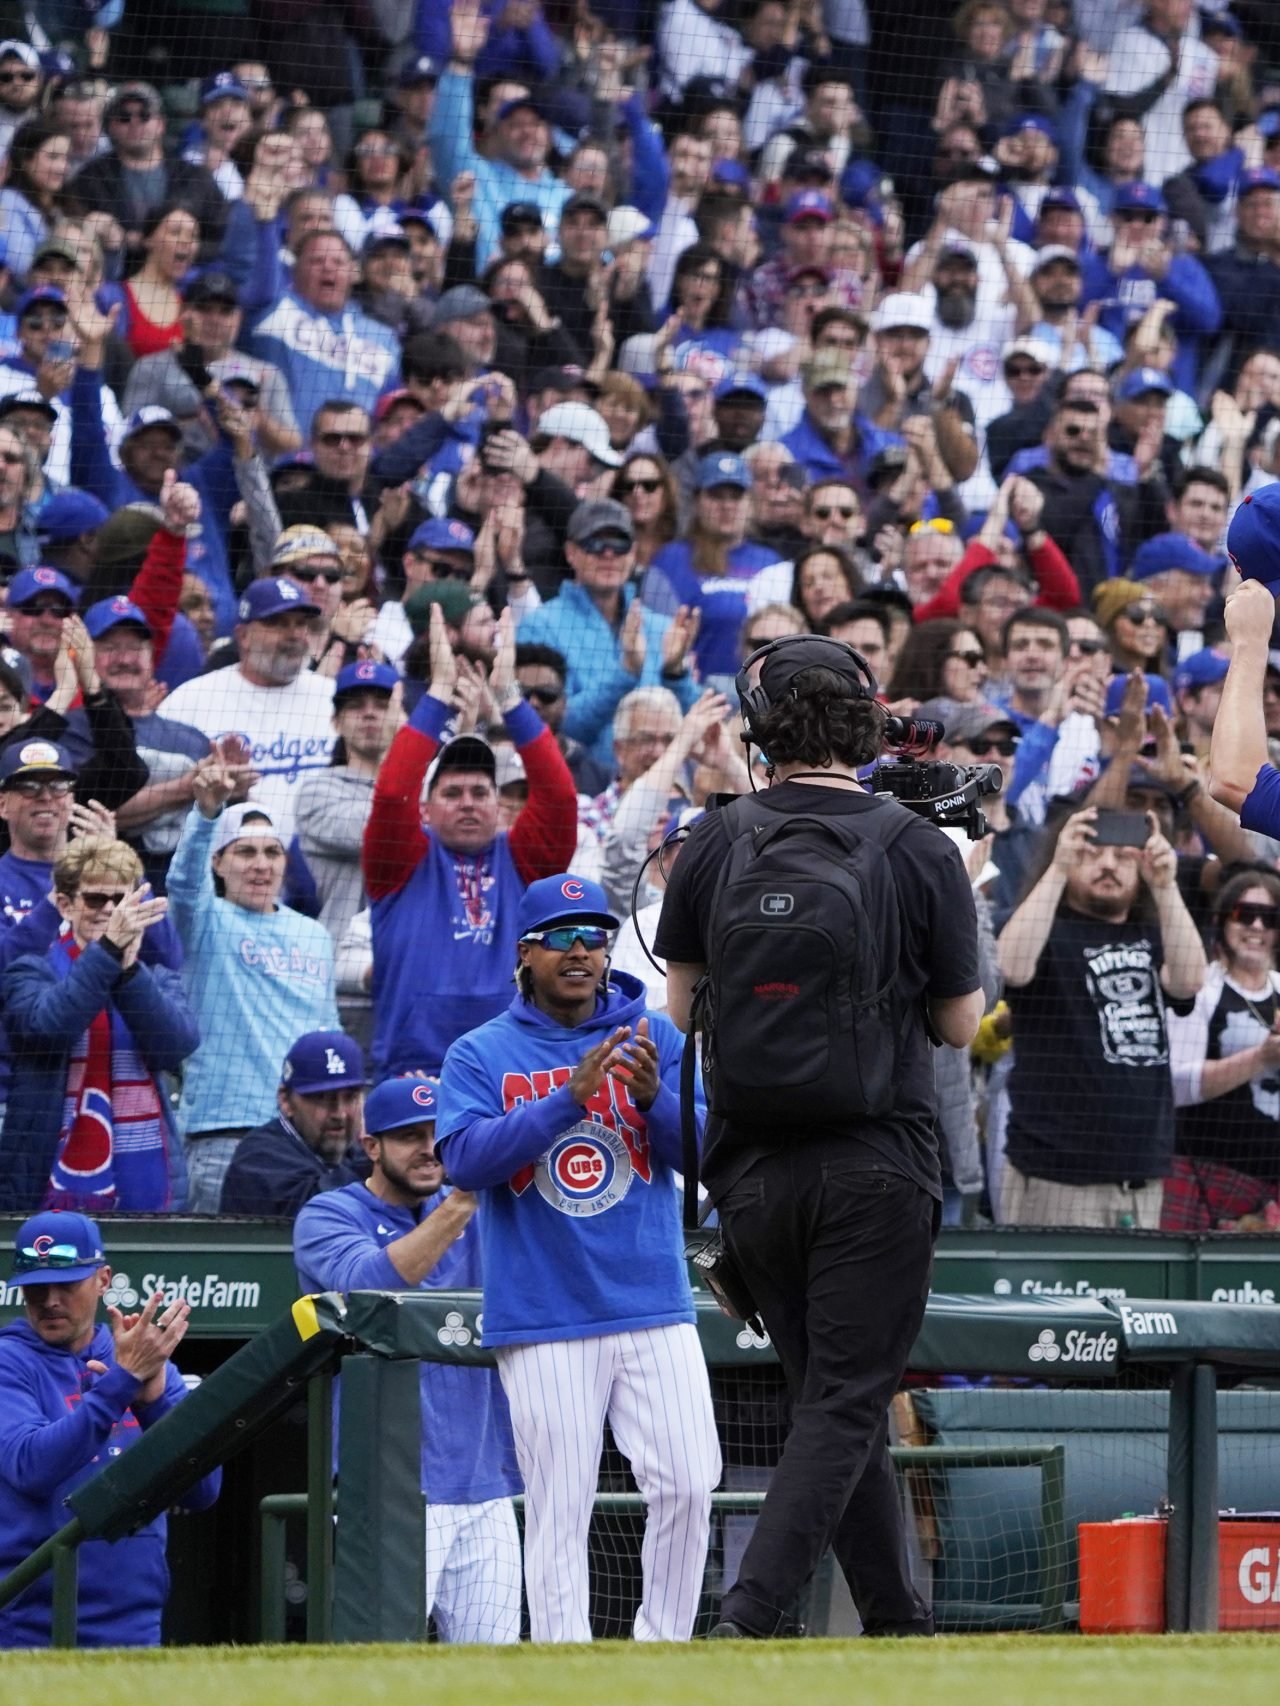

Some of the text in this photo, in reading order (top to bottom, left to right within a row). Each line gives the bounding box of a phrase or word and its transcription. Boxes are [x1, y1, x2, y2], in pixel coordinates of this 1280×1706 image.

[934, 793, 966, 812] RONIN
[561, 879, 585, 900] C
[325, 1048, 346, 1074] LA
[412, 1085, 435, 1106] C
[556, 1143, 604, 1189] CUBS
[34, 1235, 55, 1258] C
[1061, 1306, 1178, 1362] State Farm
